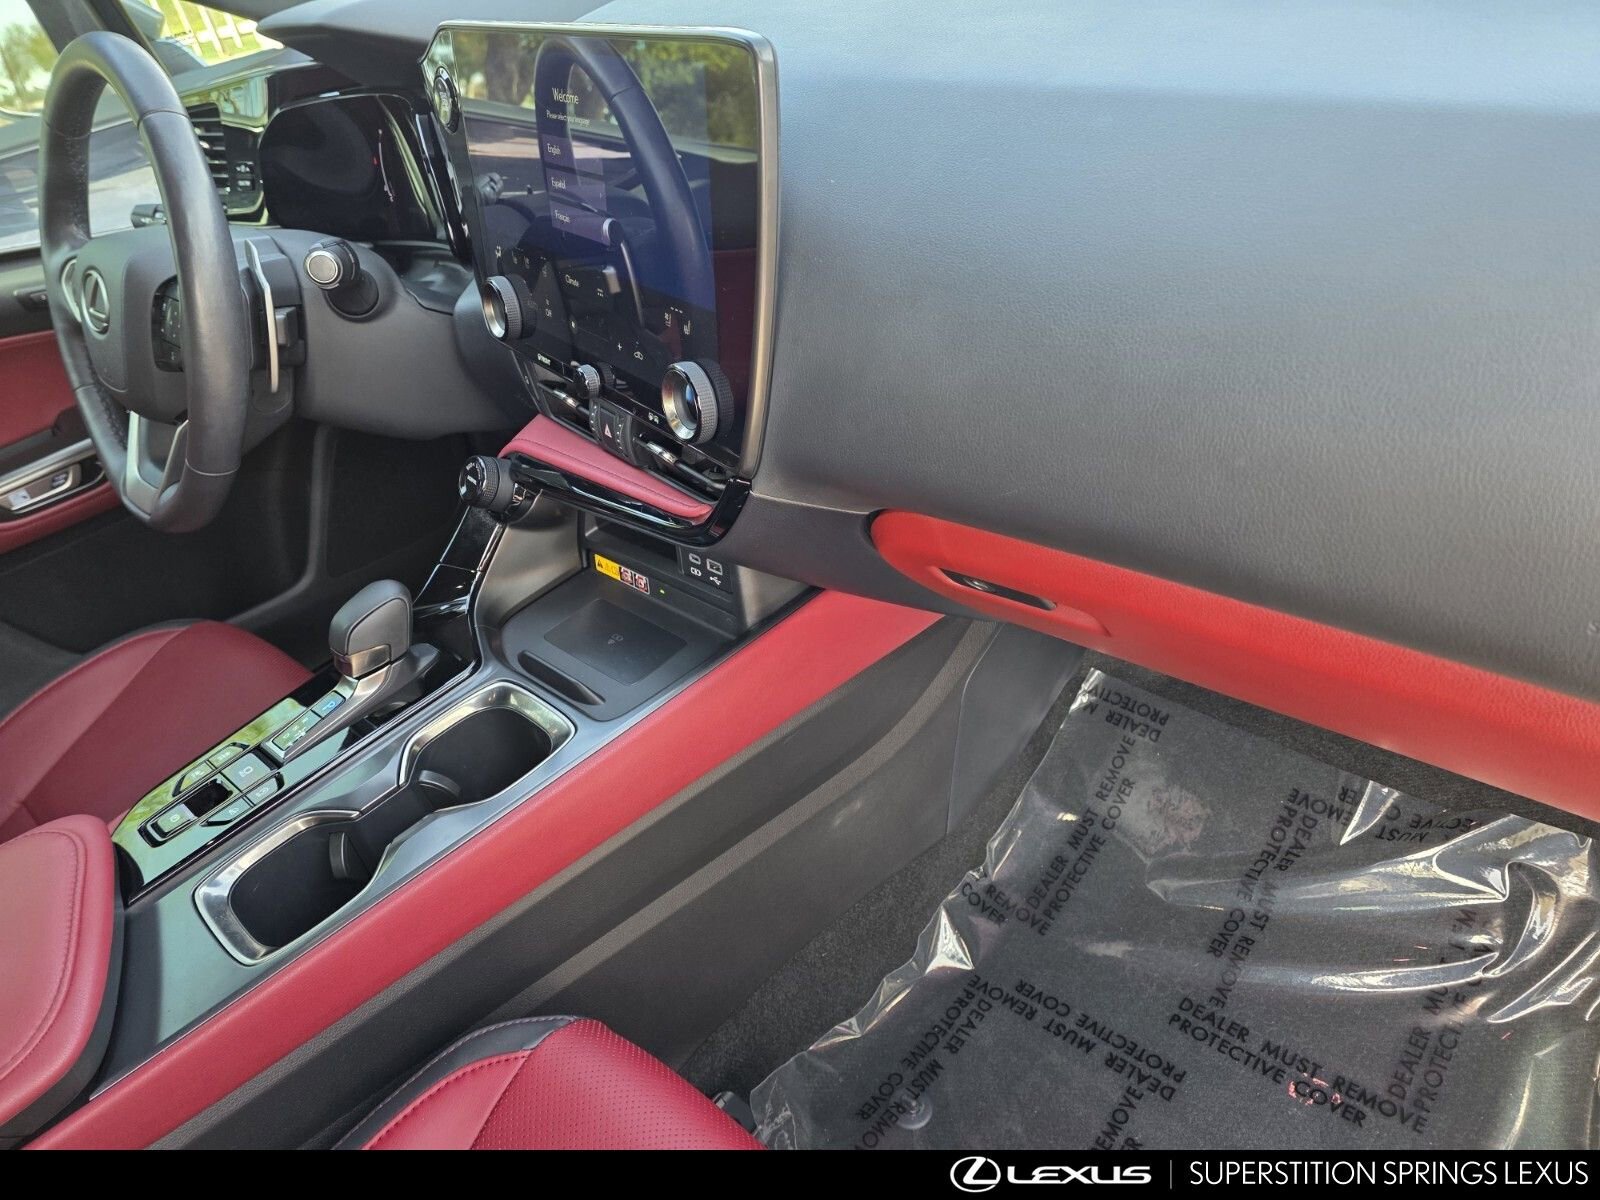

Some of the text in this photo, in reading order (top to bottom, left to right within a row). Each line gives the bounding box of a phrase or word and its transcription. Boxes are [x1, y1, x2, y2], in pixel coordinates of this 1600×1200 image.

[551, 87, 579, 105] Welcome
[546, 143, 561, 156] English
[1105, 709, 1162, 743] DEALER
[1027, 735, 1136, 910] DEALER MUST REMOVE
[1043, 777, 1136, 922] PROTECTIVE COVER
[1273, 814, 1319, 872] DEALER
[961, 882, 1006, 924] COVER
[984, 884, 1051, 936] REMOVE
[1206, 806, 1298, 959] PROTECTIVE COVER
[1209, 935, 1256, 1009] REMOVE
[855, 988, 976, 1121] PROTECTIVE COVER
[855, 999, 993, 1150] DEALER MUST REMO
[967, 974, 1176, 1101] REMOVE MUST DEALER
[1015, 979, 1187, 1083] COVER PROTECTIVE
[1168, 1013, 1367, 1128] PROTECTIVE COVER
[1178, 997, 1429, 1135] DEALER MUST REMOVE
[1387, 1026, 1432, 1101] DEALER
[1091, 1086, 1144, 1150] EMOVE
